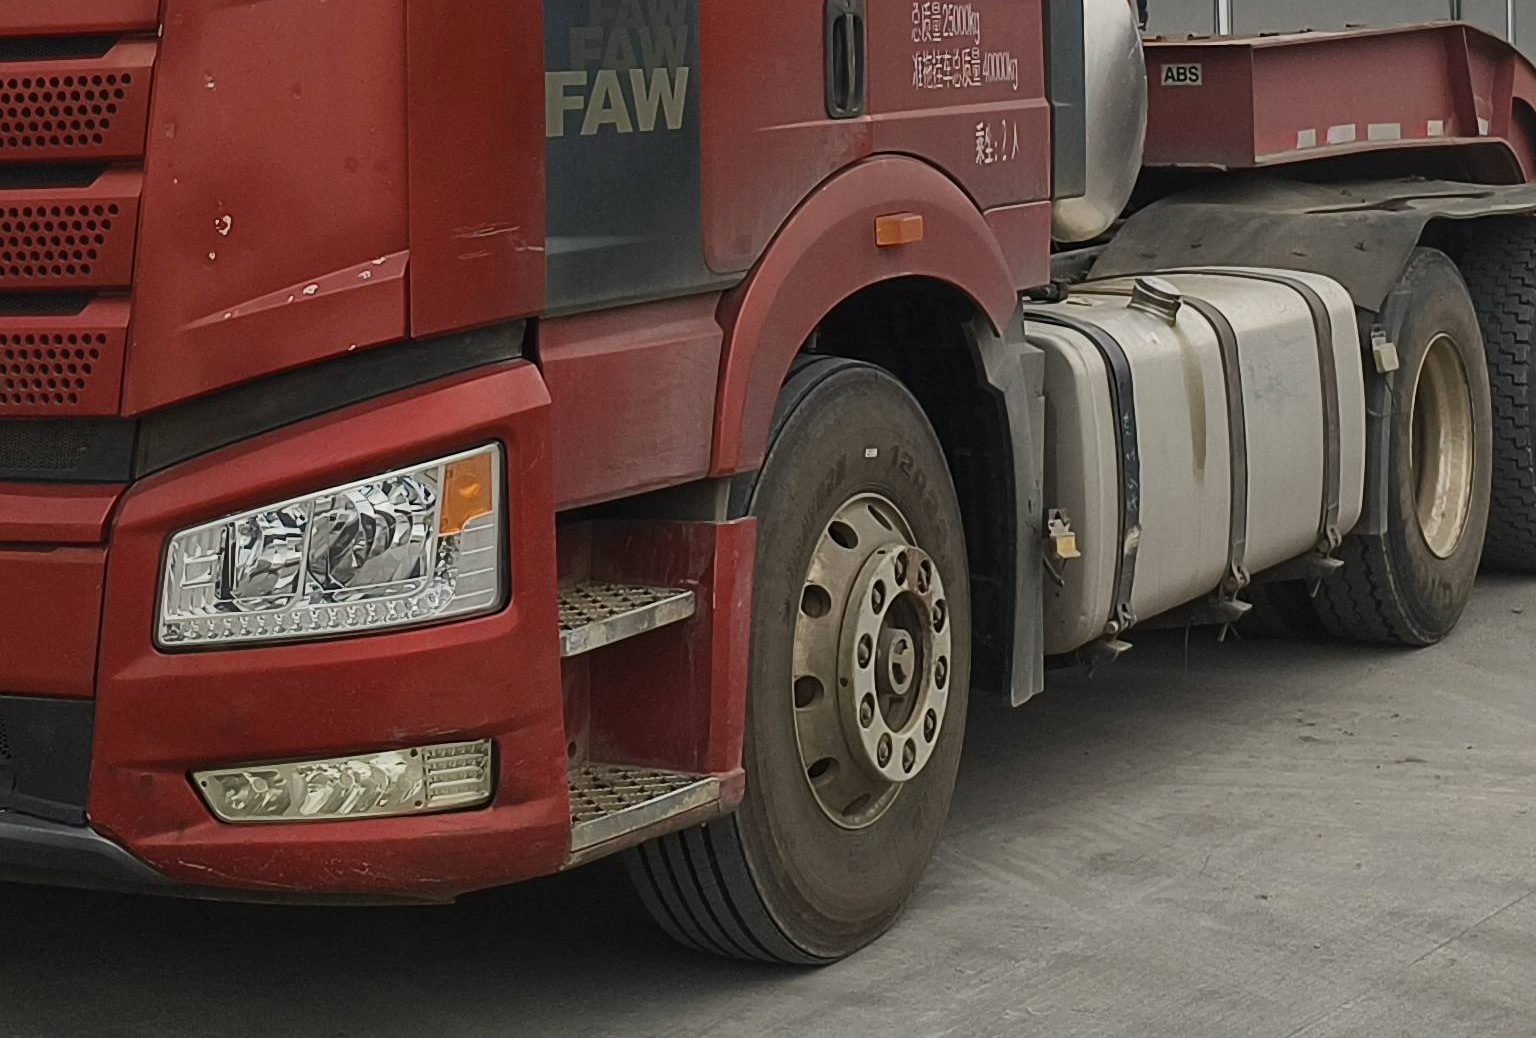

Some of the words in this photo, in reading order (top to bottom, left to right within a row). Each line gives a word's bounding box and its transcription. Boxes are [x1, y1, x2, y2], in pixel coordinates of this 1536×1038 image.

[570, 25, 688, 71] FAW
[1164, 66, 1199, 83] ABS
[545, 67, 689, 137] FAW
